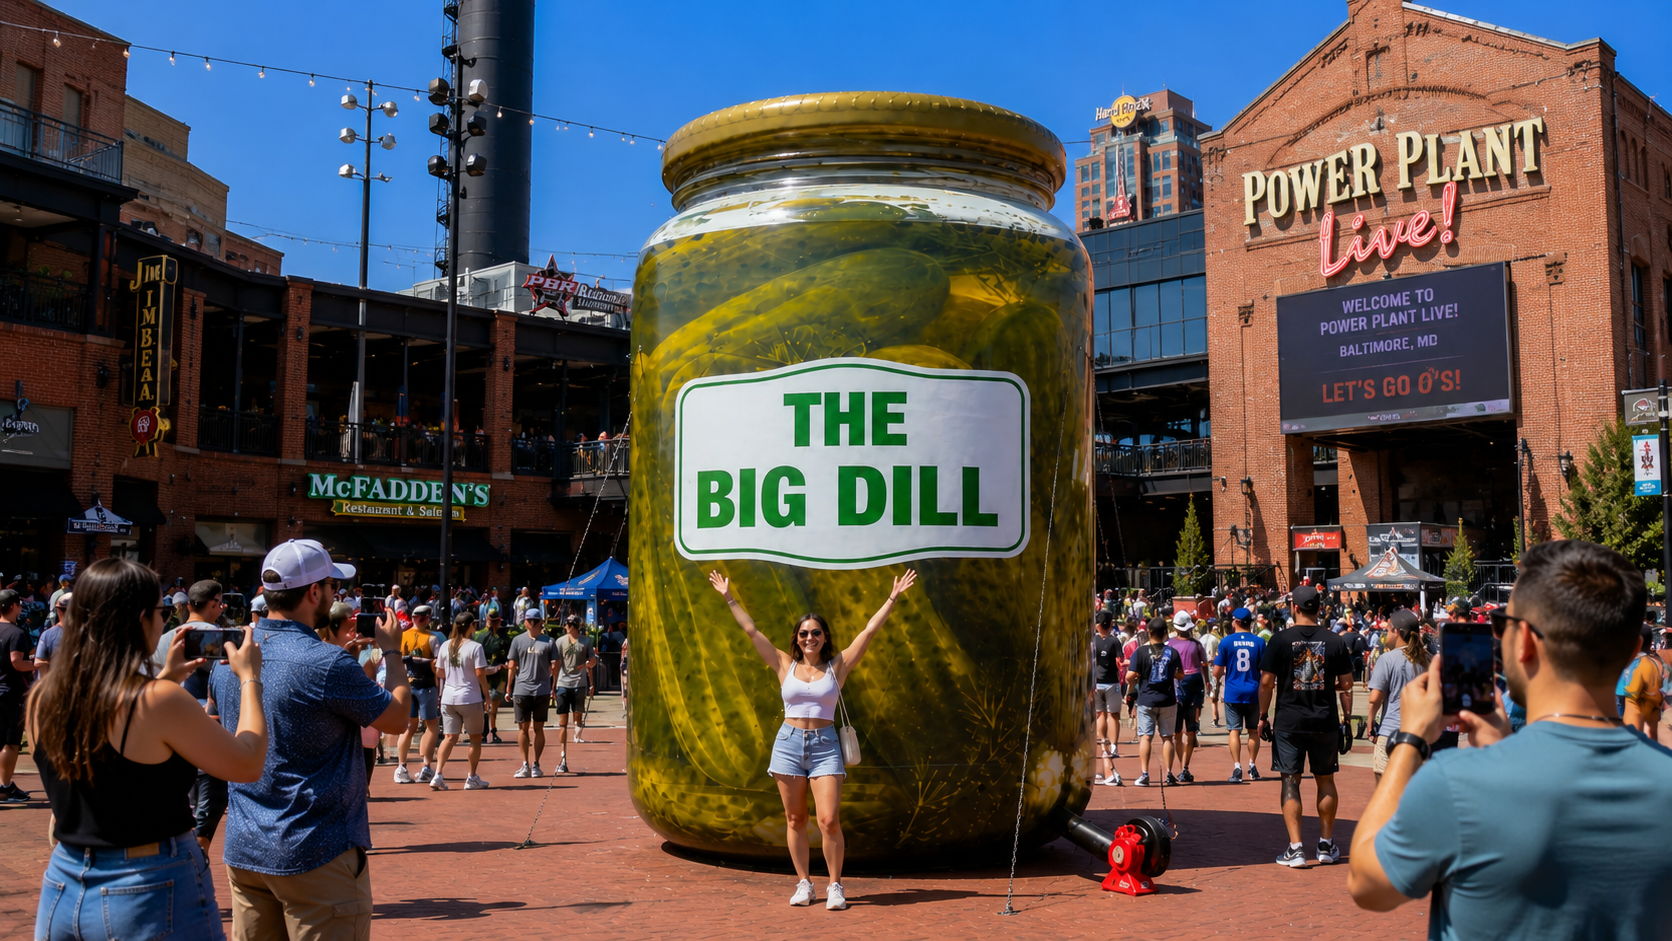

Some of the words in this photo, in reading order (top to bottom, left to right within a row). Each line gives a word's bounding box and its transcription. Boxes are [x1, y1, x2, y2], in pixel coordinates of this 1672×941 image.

[1242, 142, 1381, 226] POWER
[1396, 117, 1543, 190] PLANT
[1320, 181, 1457, 278] Live!
[527, 275, 578, 293] PBR
[1342, 291, 1411, 314] WELCOME
[1415, 287, 1434, 303] TO
[1320, 316, 1367, 336] POWER
[1372, 309, 1417, 329] PLANT
[1422, 303, 1459, 322] LIVE!
[1339, 337, 1414, 357] BALTIMORE,
[1417, 334, 1438, 348] MD
[1322, 378, 1376, 404] LET'S
[1383, 375, 1411, 397] GO
[783, 391, 907, 447] THE
[309, 473, 491, 506] McFADDEN'S
[697, 465, 806, 529] BIG
[838, 465, 998, 527] DILL
[406, 506, 414, 516] &
[1236, 648, 1251, 673] 8
